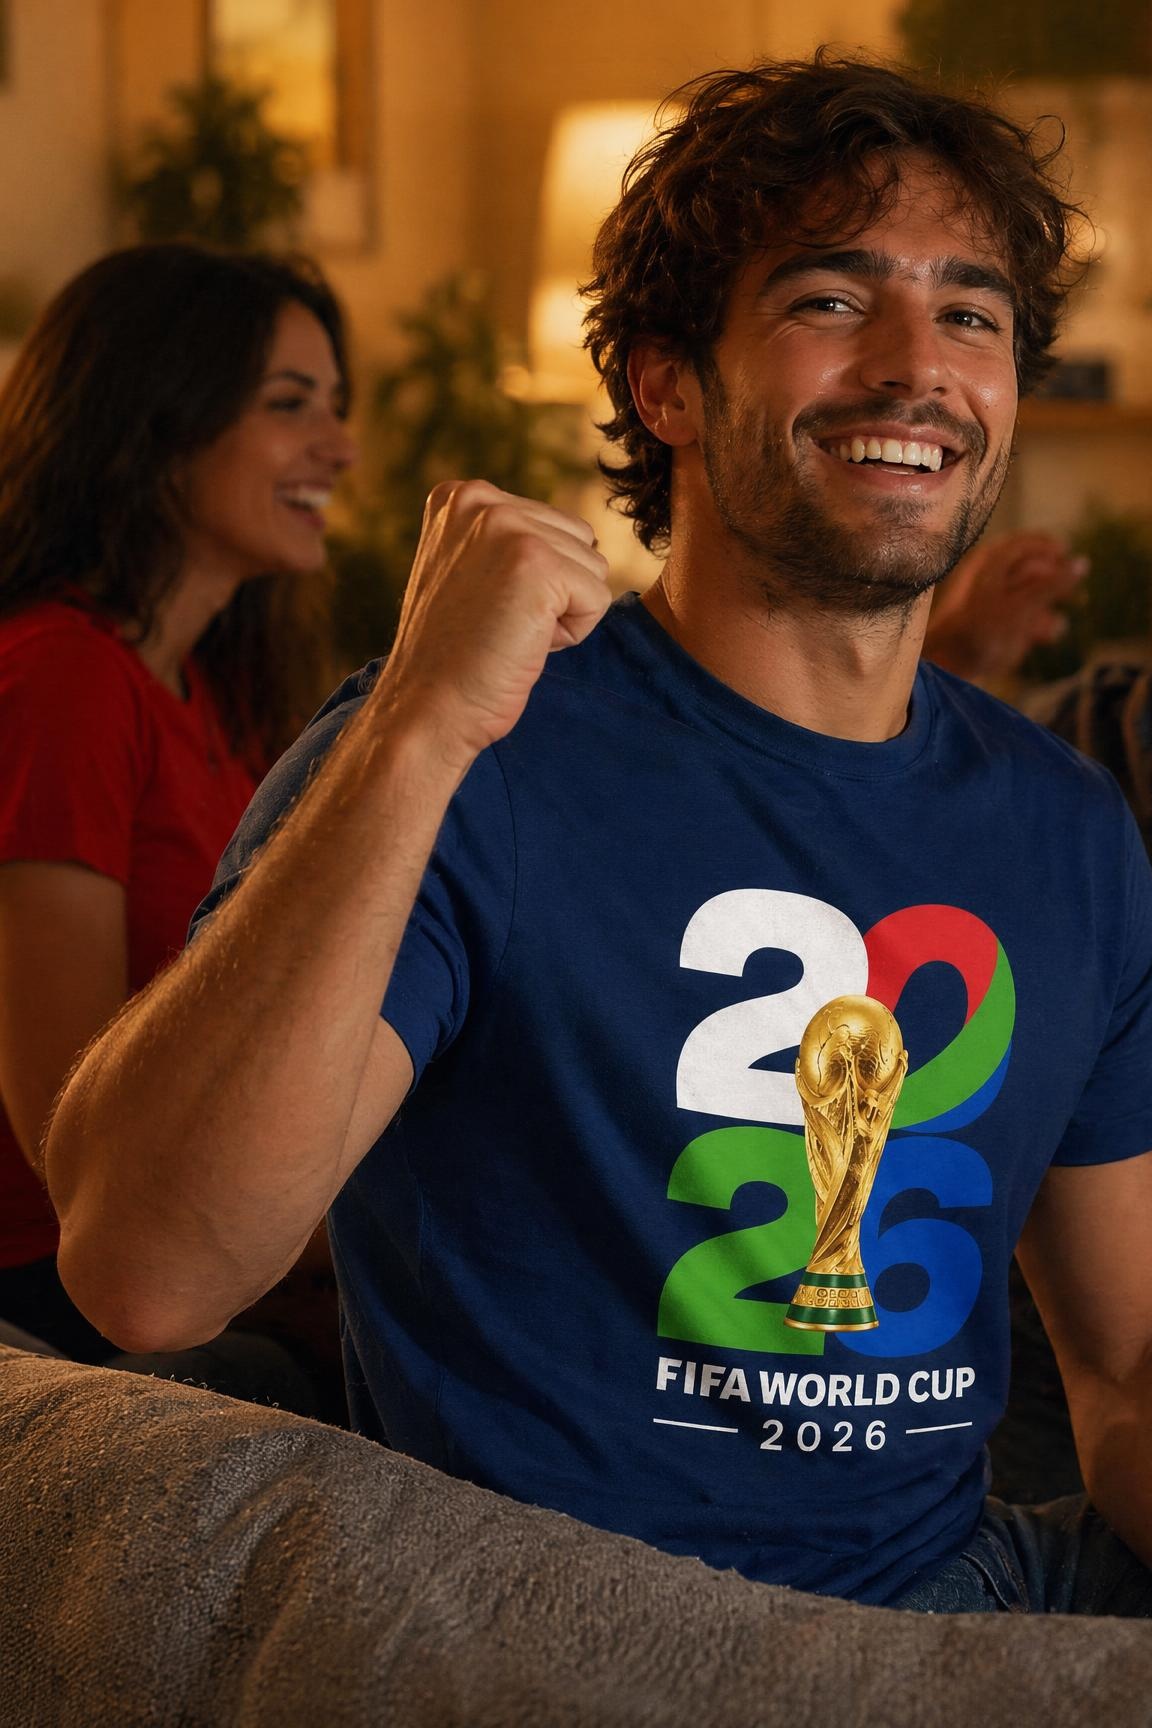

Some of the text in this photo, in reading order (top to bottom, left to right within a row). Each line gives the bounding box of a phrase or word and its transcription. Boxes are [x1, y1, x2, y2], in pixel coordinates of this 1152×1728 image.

[676, 888, 1016, 1134] 20
[657, 1126, 993, 1358] 26
[656, 1356, 976, 1407] FIFA WORLD CUP
[759, 1419, 886, 1452] 2026
